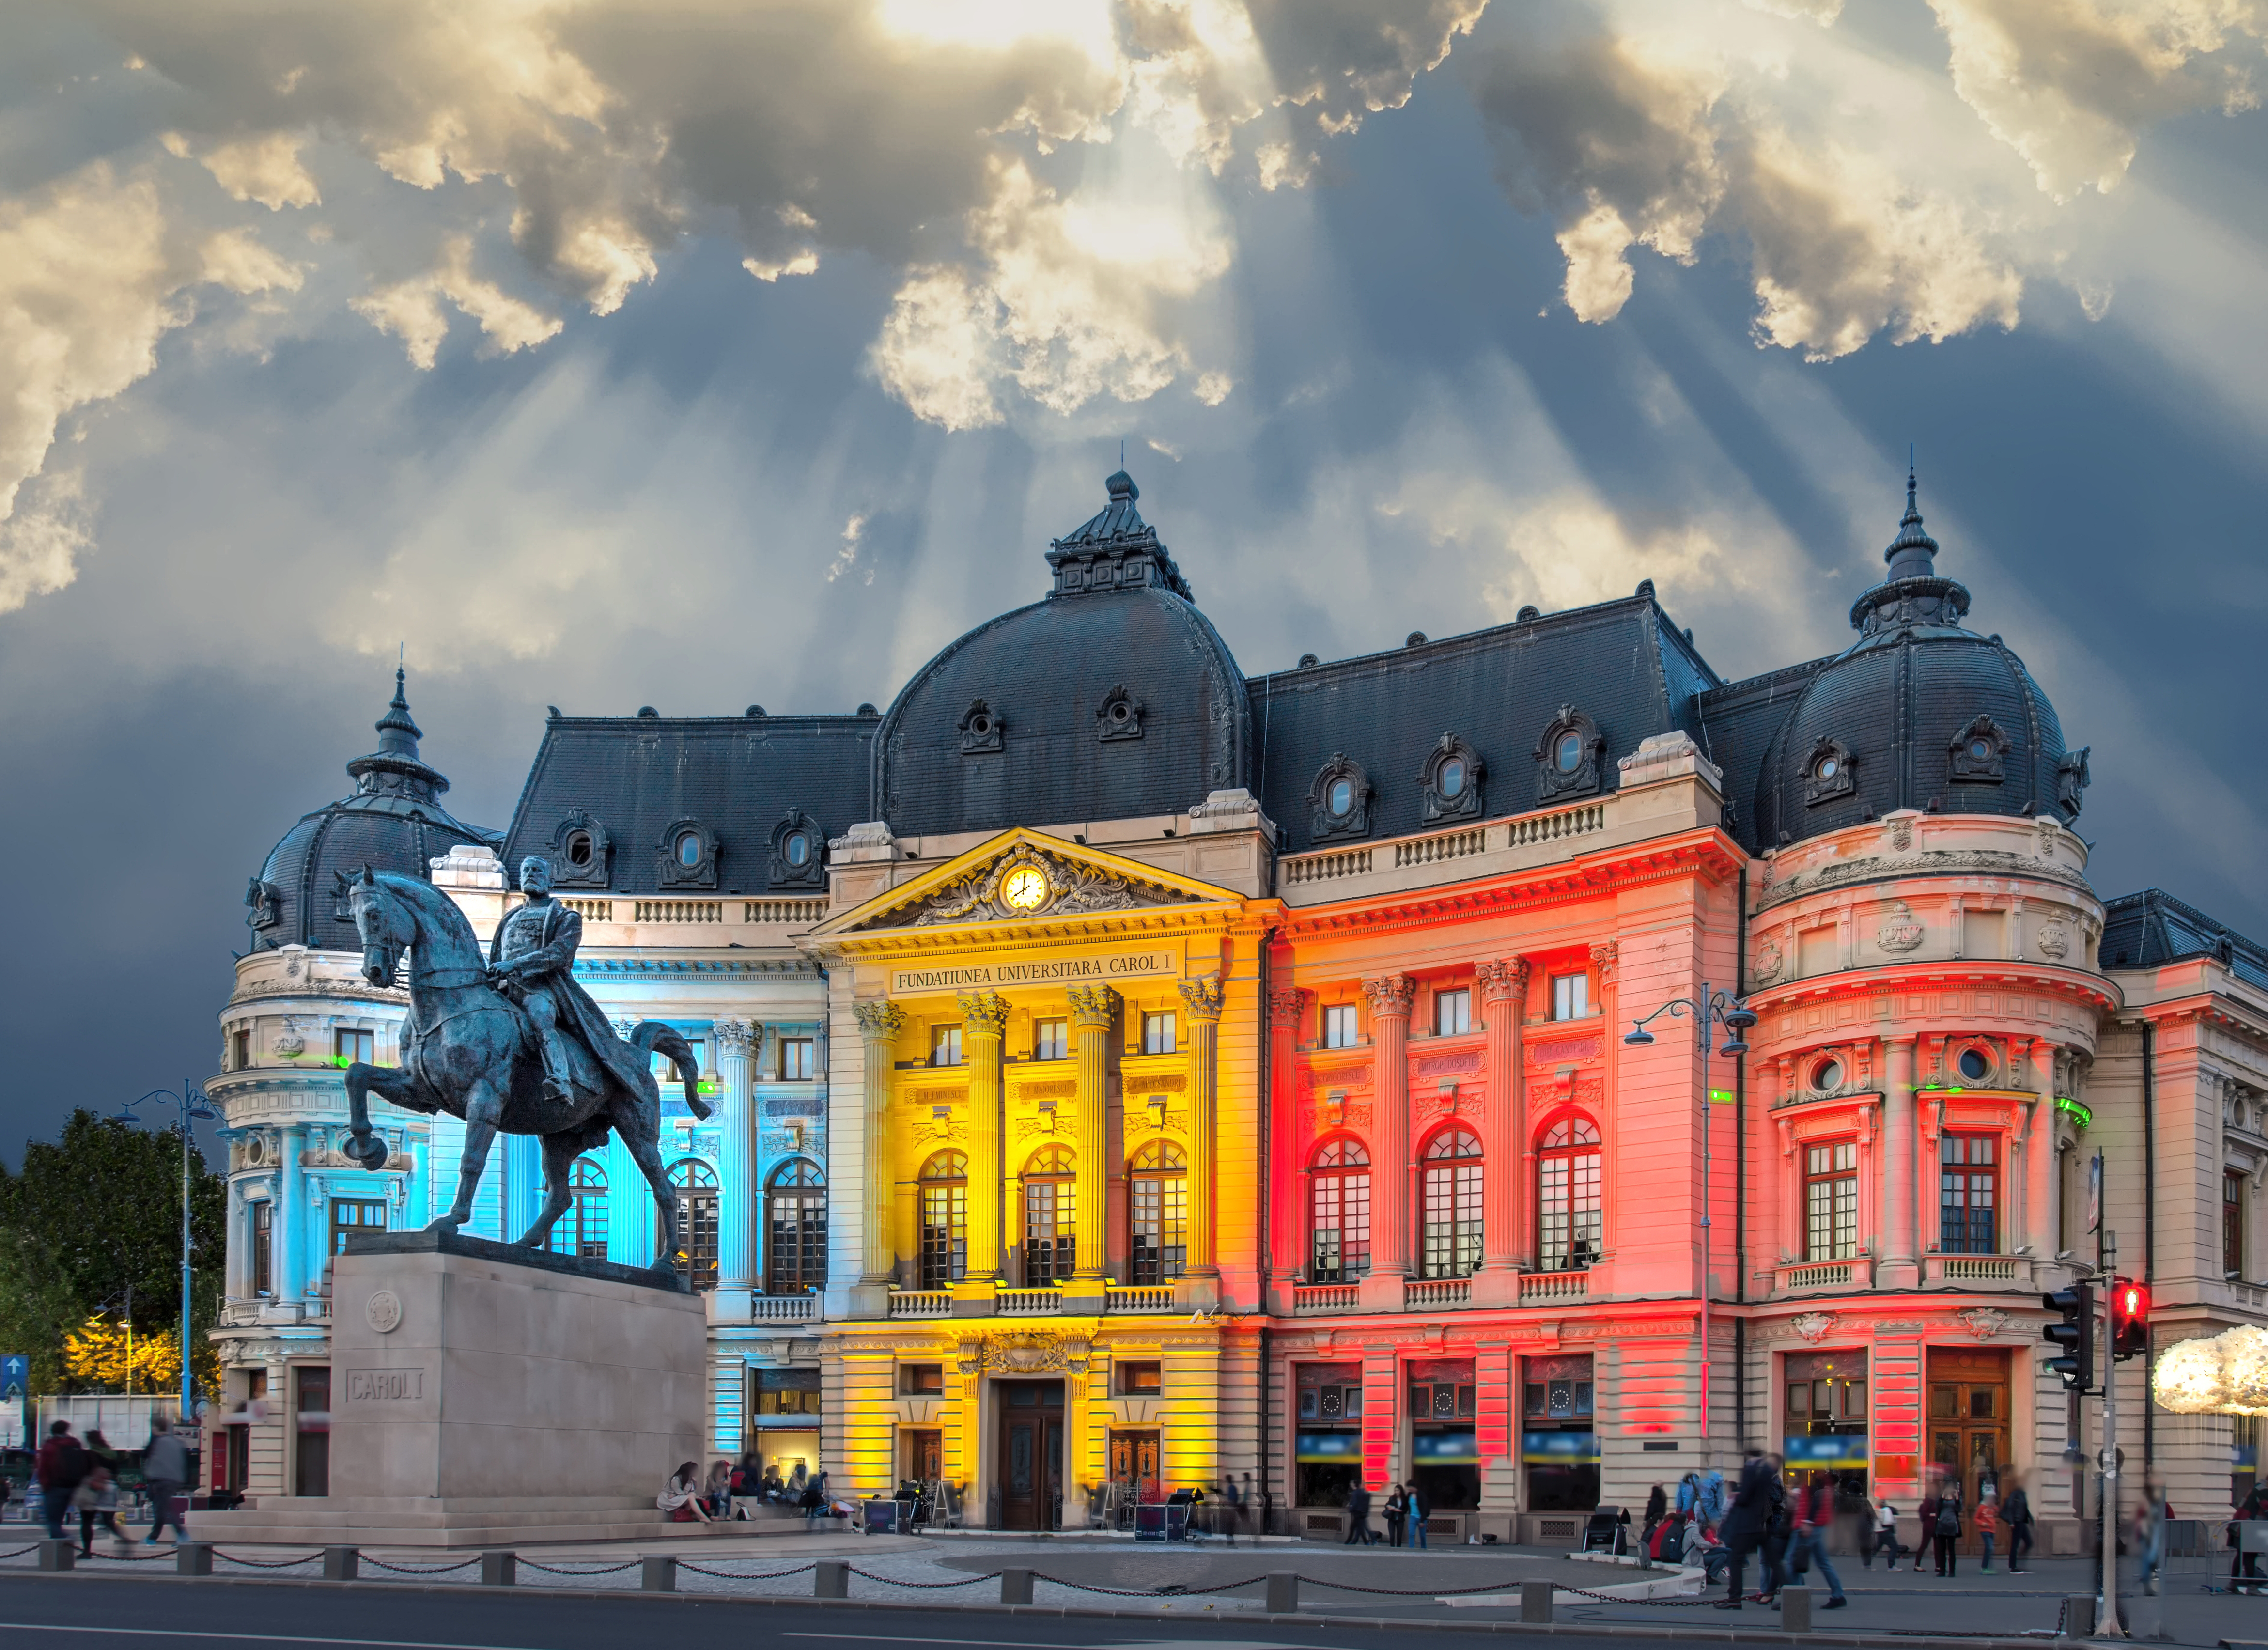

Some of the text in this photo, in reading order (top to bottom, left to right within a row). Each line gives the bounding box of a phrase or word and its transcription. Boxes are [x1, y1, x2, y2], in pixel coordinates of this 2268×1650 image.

[899, 954, 1170, 988] FUNDATIUNEA UNIVERSITARA CAROL I
[1322, 1070, 1360, 1083] GRIGORESCU
[352, 1373, 423, 1399] CAROL I
